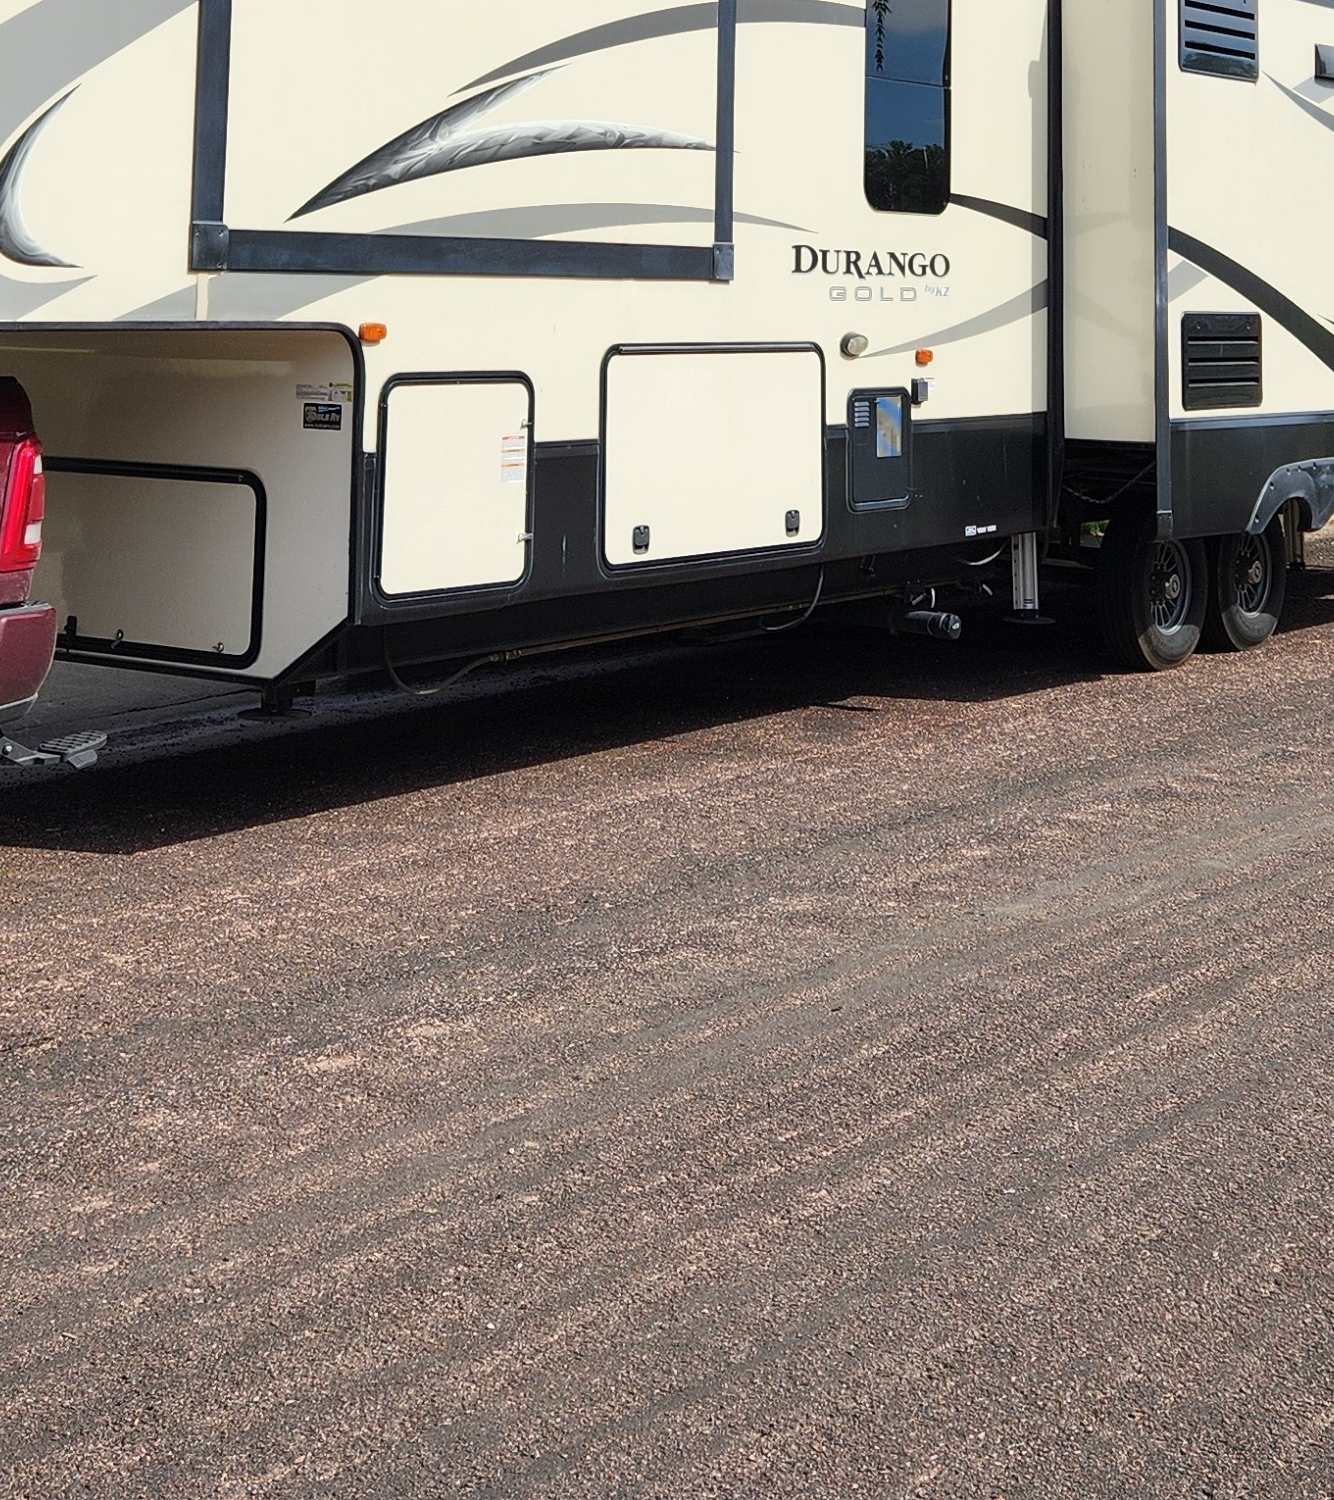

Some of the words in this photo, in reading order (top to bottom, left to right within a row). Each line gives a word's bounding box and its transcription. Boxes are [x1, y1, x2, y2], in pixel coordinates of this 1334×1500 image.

[791, 244, 950, 279] DURANGO
[829, 286, 917, 301] GOLD
[935, 286, 950, 297] KZ
